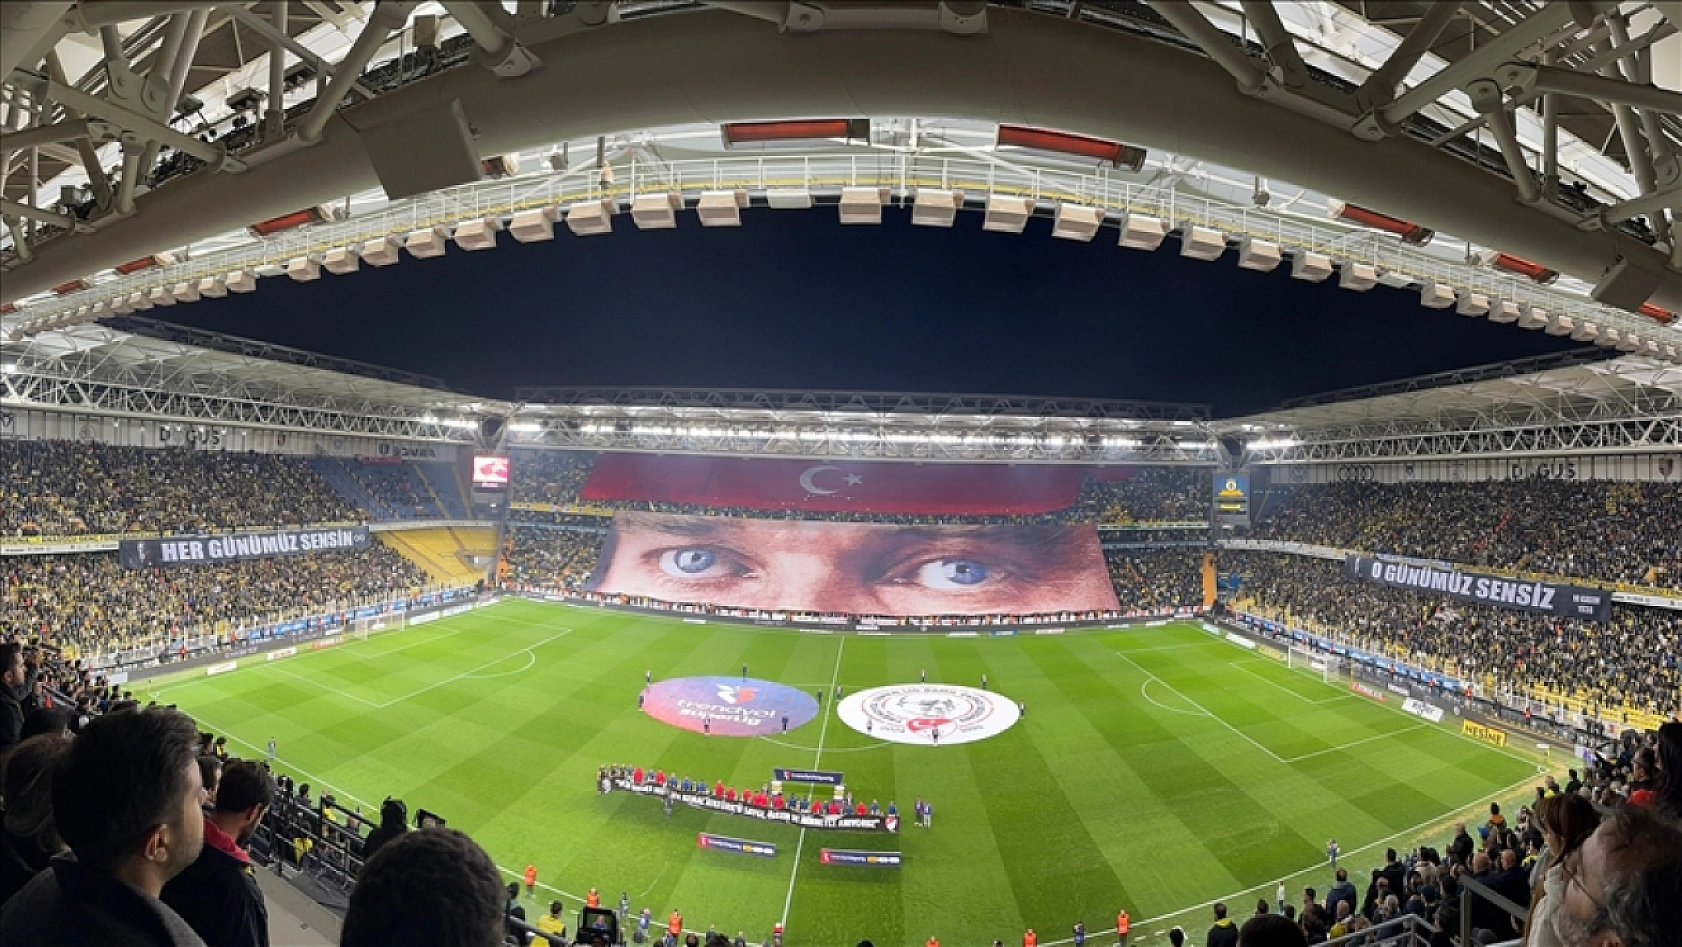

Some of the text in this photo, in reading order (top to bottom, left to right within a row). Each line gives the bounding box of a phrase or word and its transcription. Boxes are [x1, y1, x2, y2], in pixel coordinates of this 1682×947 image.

[161, 530, 352, 562] HER GÜNÜMÜZ SENSİN
[1372, 562, 1556, 610] O GÜNÜMÜZ SENSİZ
